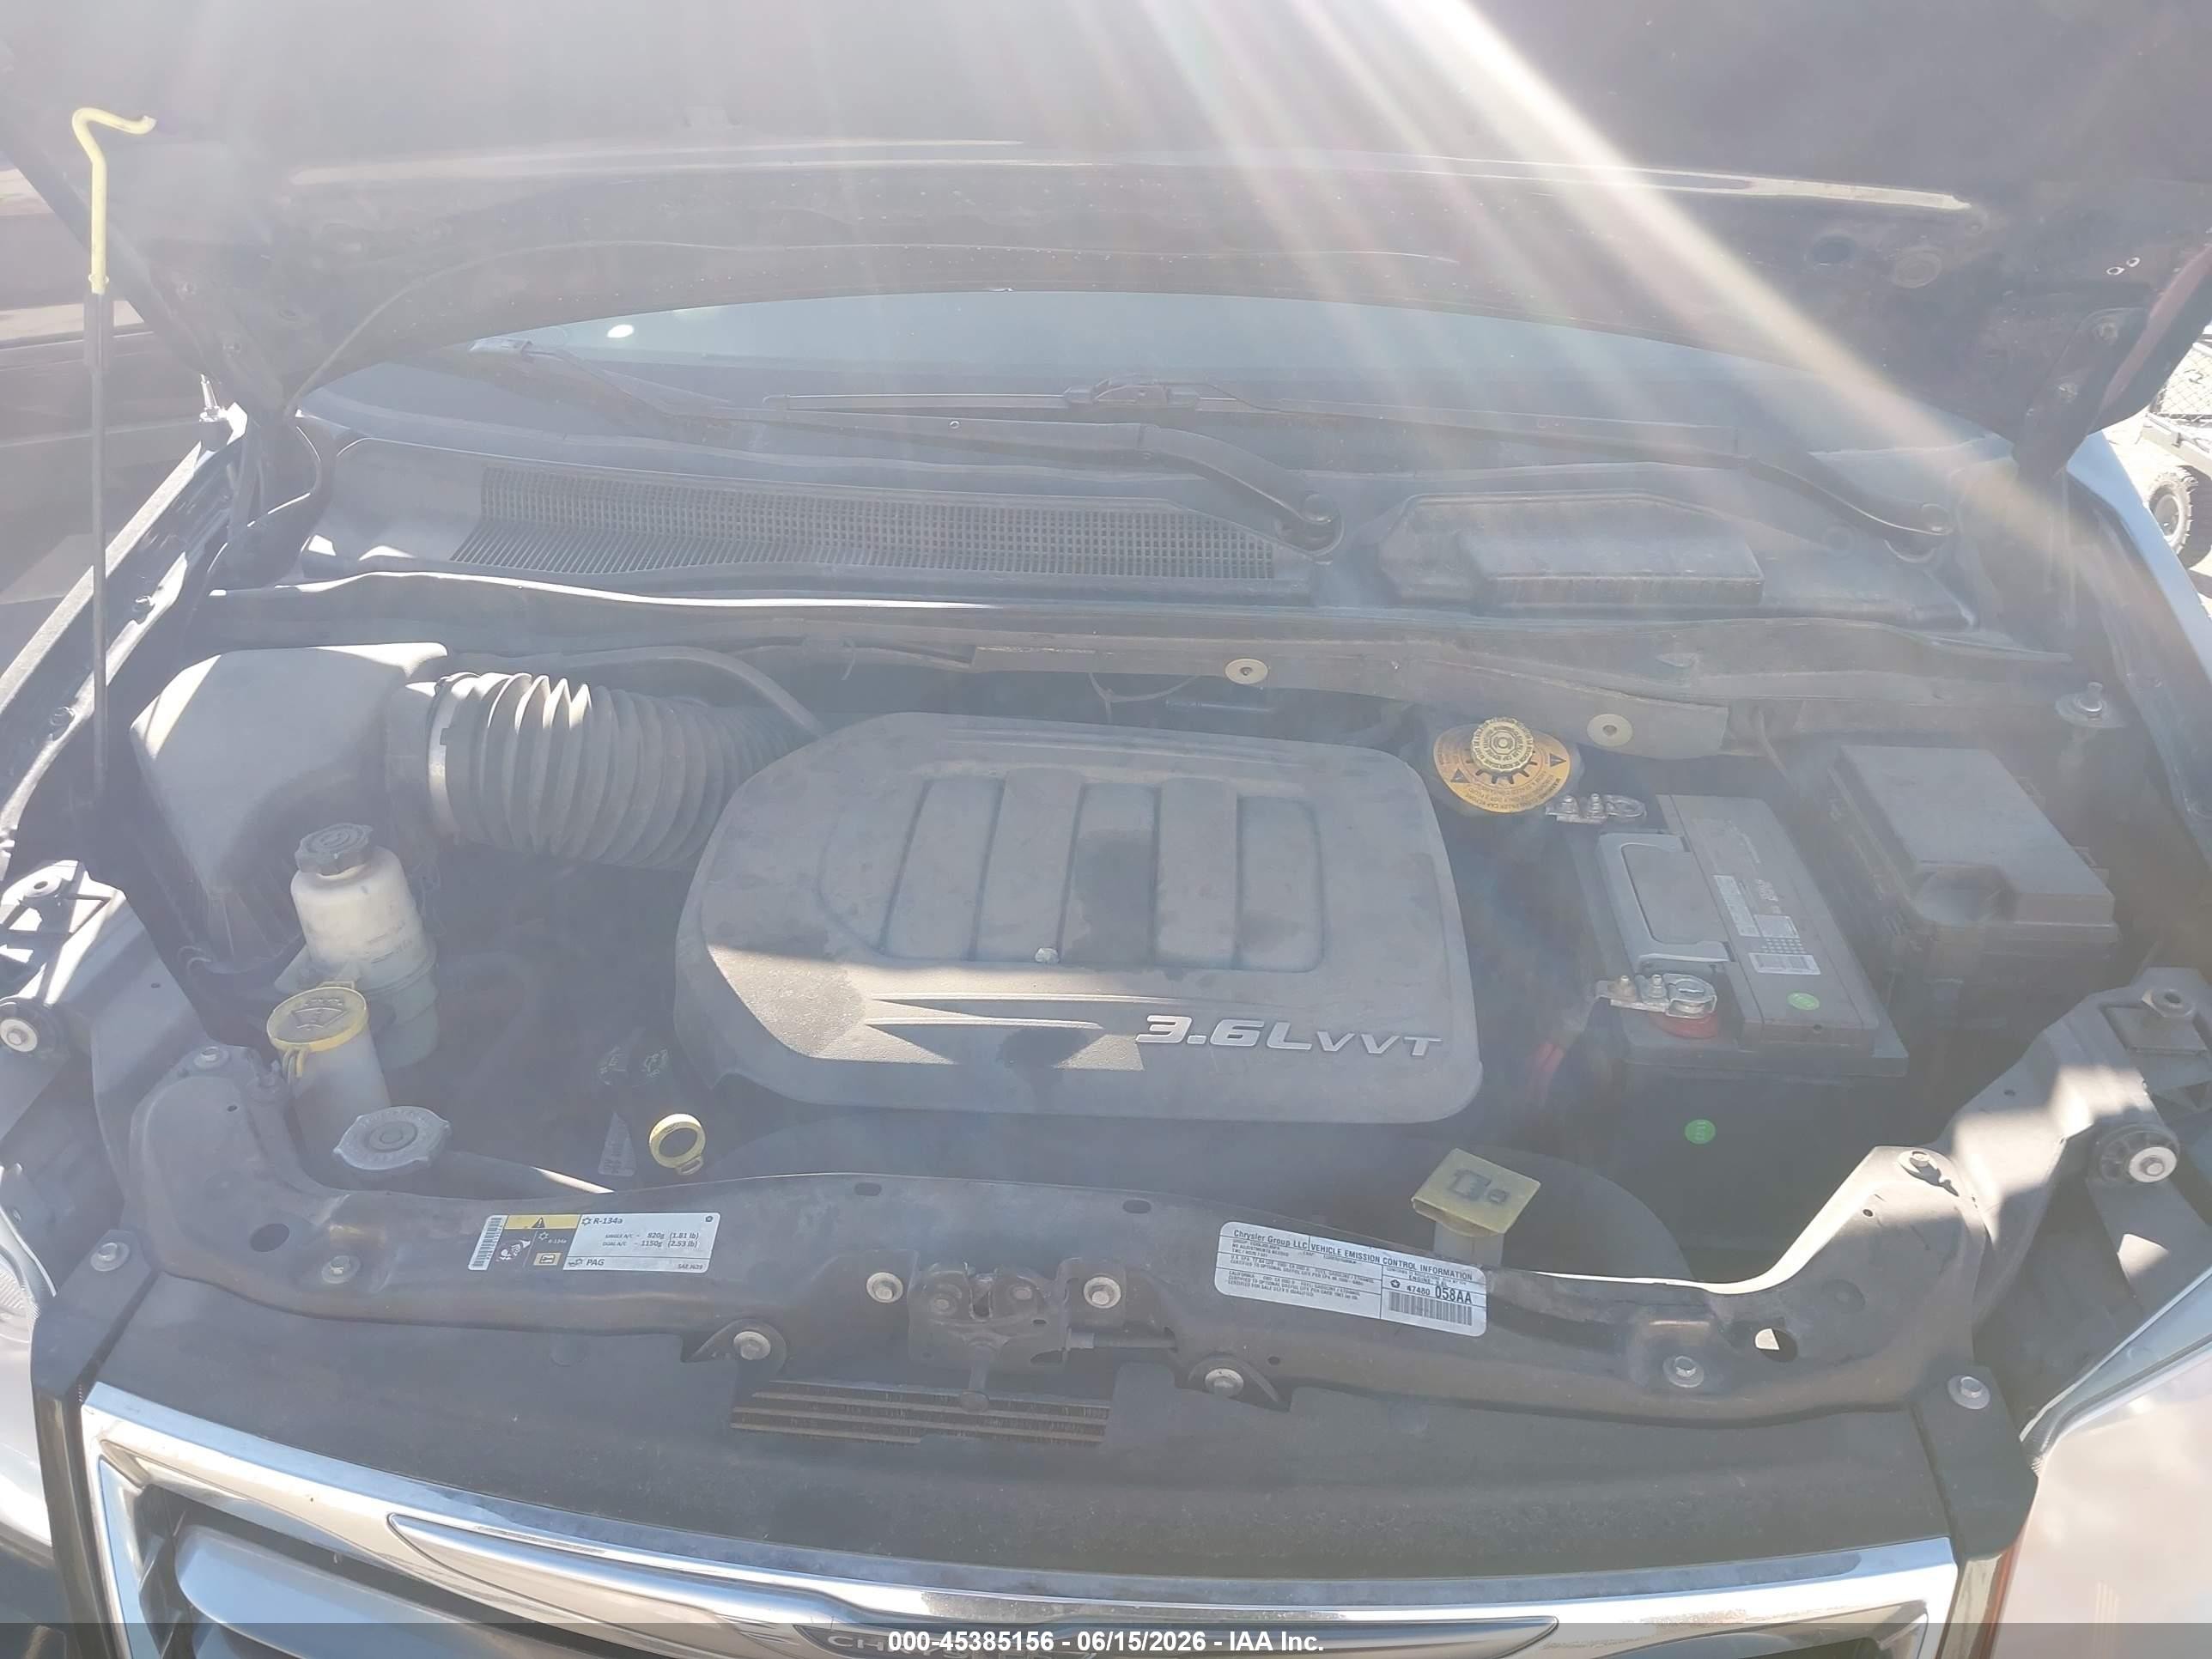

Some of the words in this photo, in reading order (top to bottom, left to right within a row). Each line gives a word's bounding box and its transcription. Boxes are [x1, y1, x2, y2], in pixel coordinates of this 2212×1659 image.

[1233, 1230, 1265, 1243] Chrysler
[1267, 1236, 1291, 1247] Group
[1292, 1241, 1308, 1249] LLC
[586, 1258, 605, 1267] PAG
[1310, 1243, 1341, 1255] VEHICLE
[1344, 1250, 1381, 1263] EMISSION
[1382, 1257, 1417, 1269] CONTROL
[1419, 1264, 1473, 1280] INFORMATION
[1434, 1285, 1474, 1304] 058AA
